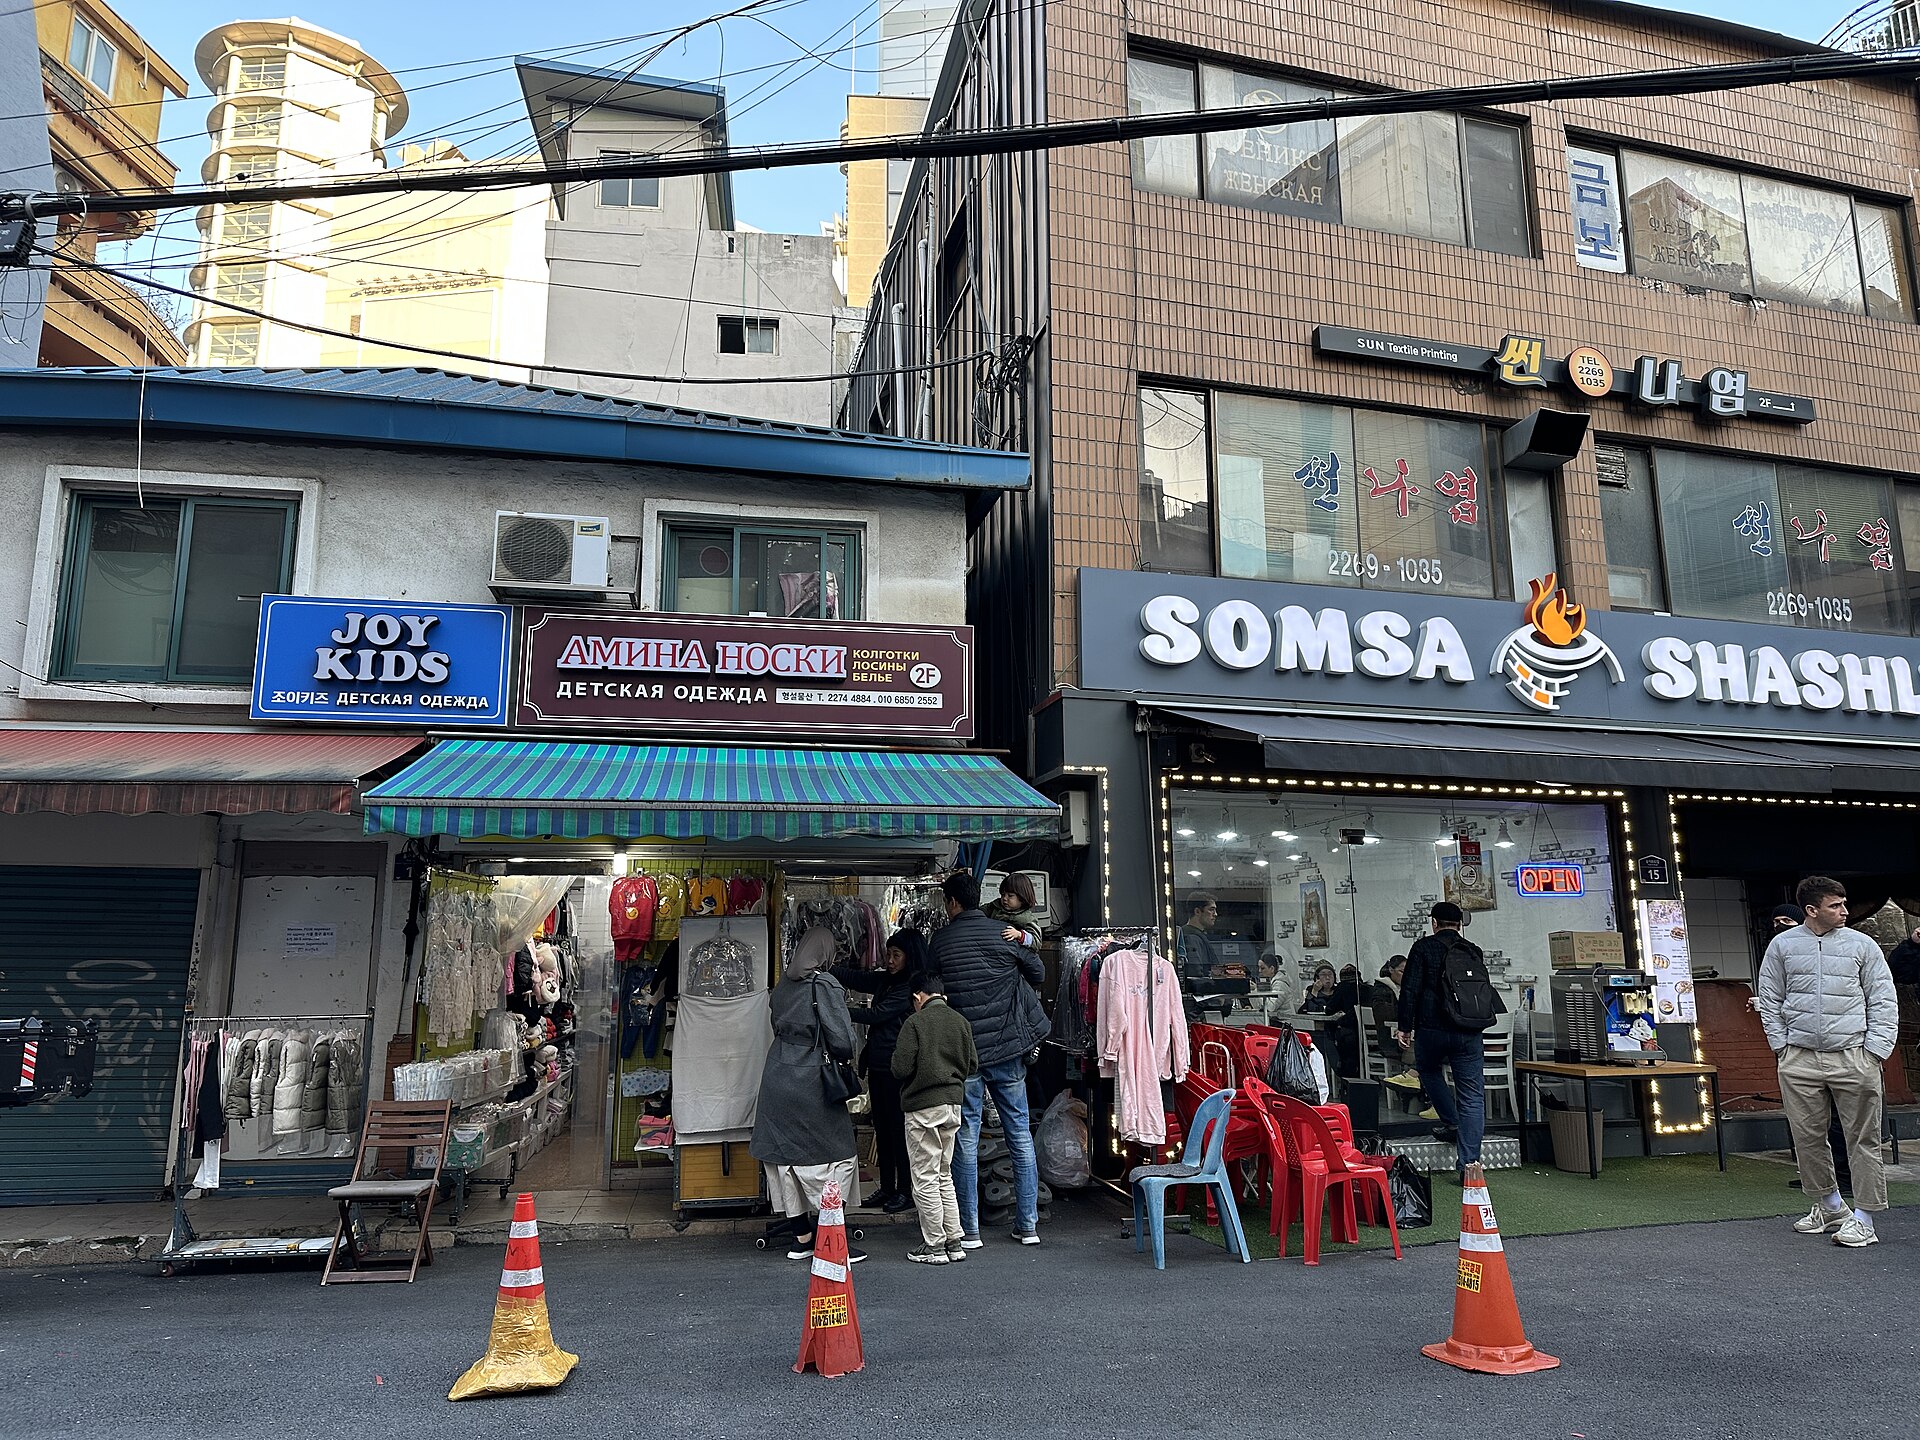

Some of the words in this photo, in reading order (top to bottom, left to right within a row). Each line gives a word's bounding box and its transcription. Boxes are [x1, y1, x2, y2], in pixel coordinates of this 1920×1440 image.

[1228, 139, 1322, 171] ЕНИКС
[1223, 169, 1323, 206] ЖЕНСКАЯ
[1357, 338, 1384, 351] SUN
[1387, 342, 1419, 356] Textile
[1421, 347, 1458, 362] Printing
[1579, 355, 1600, 366] TEL
[1499, 337, 1545, 384] 썬
[1709, 369, 1746, 414] 염
[1577, 366, 1604, 377] 2269
[1579, 377, 1605, 388] 1035
[1758, 398, 1772, 408] 2F
[331, 612, 440, 648] JOY
[1138, 594, 1475, 683] SOMSA
[557, 636, 711, 674] АМИНА
[715, 641, 847, 678] НОСКИ
[852, 649, 920, 661] КОЛГОТКИ
[313, 647, 450, 684] KIDS
[852, 661, 907, 672] ЛОСИНЫ
[852, 673, 893, 683] БЕЛЬЕ
[915, 667, 936, 684] 2F
[1641, 637, 1920, 718] SHASHL
[270, 690, 329, 705] 조이키즈
[336, 692, 413, 706] ДЕТСКАЯ
[419, 694, 489, 710] ОДЕЖДА
[556, 681, 664, 699] ДЕТСКАЯ
[673, 685, 768, 703] ОДЕЖДА
[827, 693, 848, 702] 2274
[850, 694, 871, 703] 4884
[877, 695, 892, 704] 010
[894, 695, 915, 704] 6850
[917, 696, 938, 705] 2552
[1521, 868, 1581, 893] OPEN
[1647, 869, 1660, 880] 15
